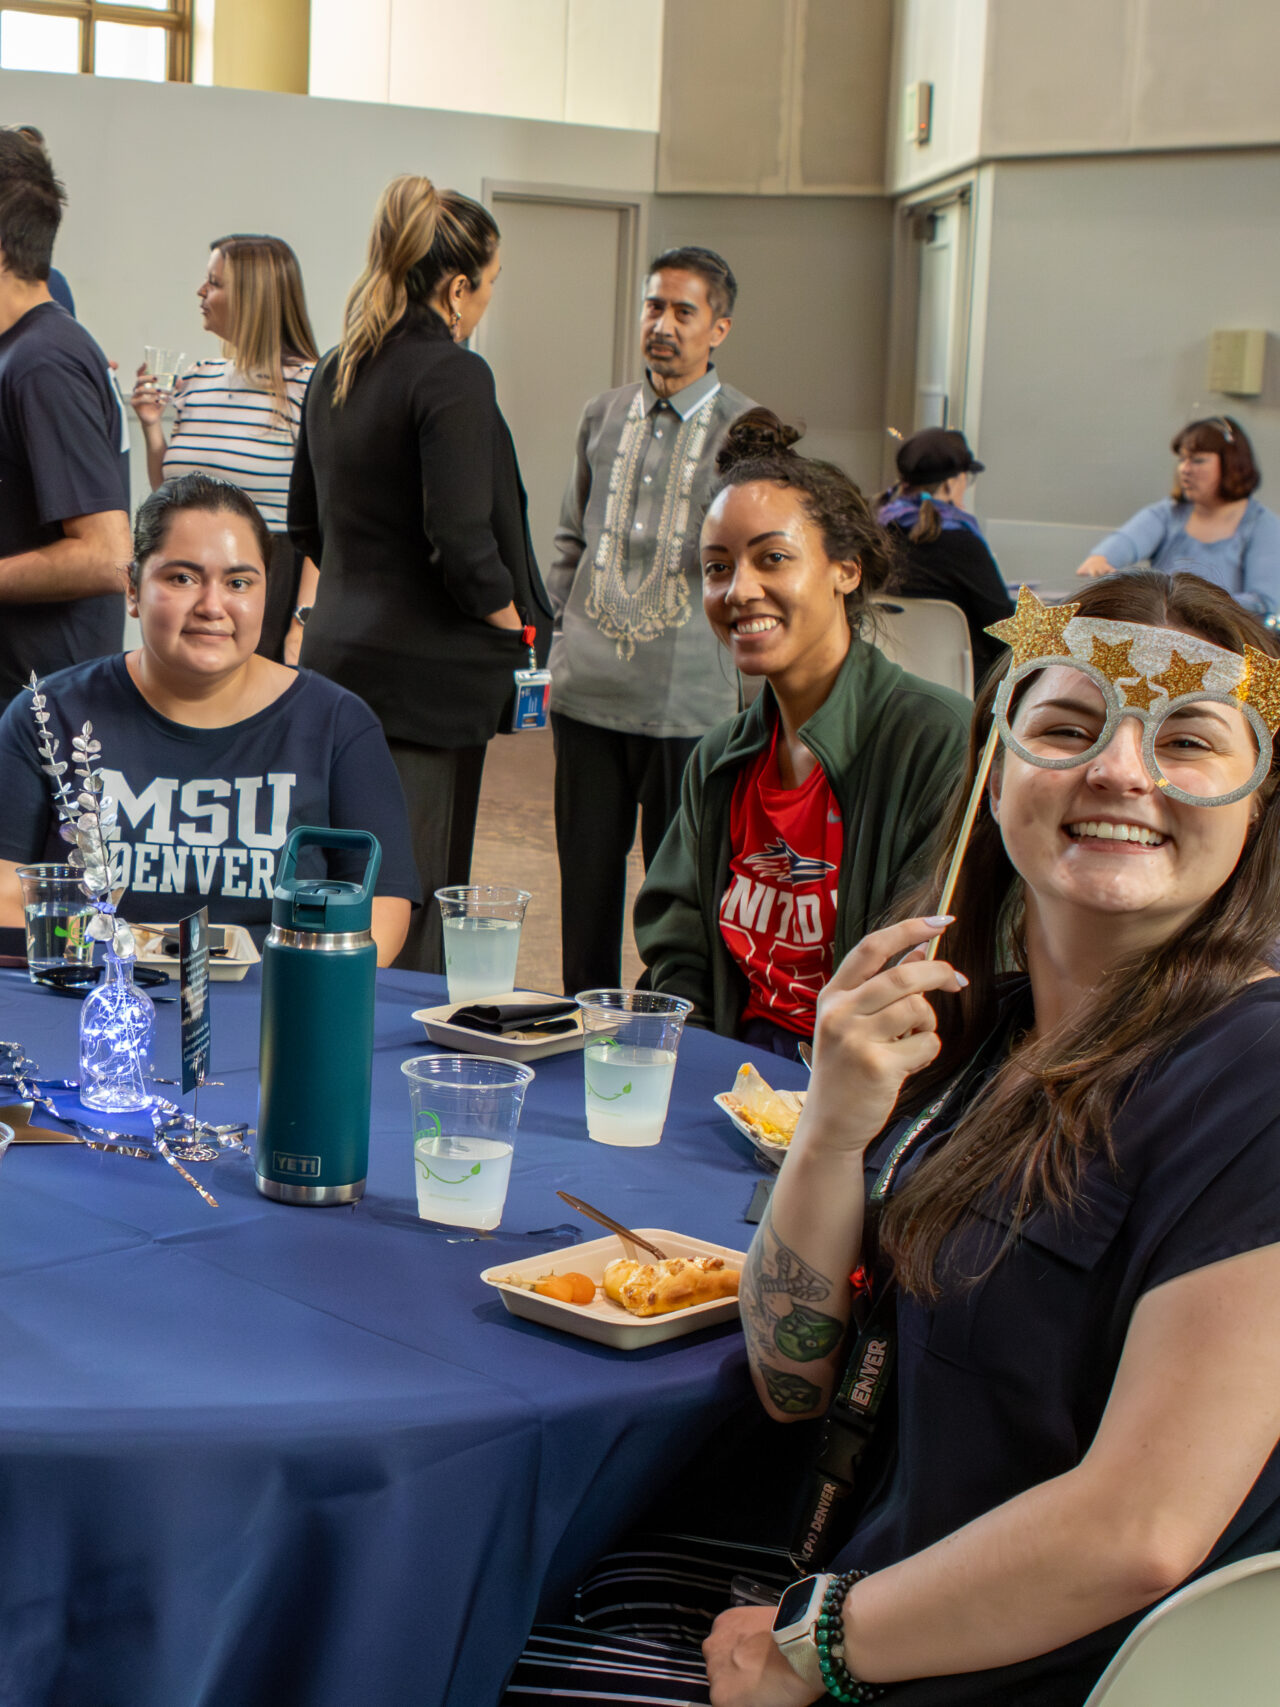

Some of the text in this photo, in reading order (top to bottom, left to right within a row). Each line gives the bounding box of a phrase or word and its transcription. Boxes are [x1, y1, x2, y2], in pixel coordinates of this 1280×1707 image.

[99, 768, 297, 850] MSU
[107, 841, 276, 900] DENVER
[720, 873, 824, 944] NITD
[277, 1156, 317, 1174] YETI
[849, 1339, 888, 1415] ENVER
[810, 1482, 837, 1533] DENVER
